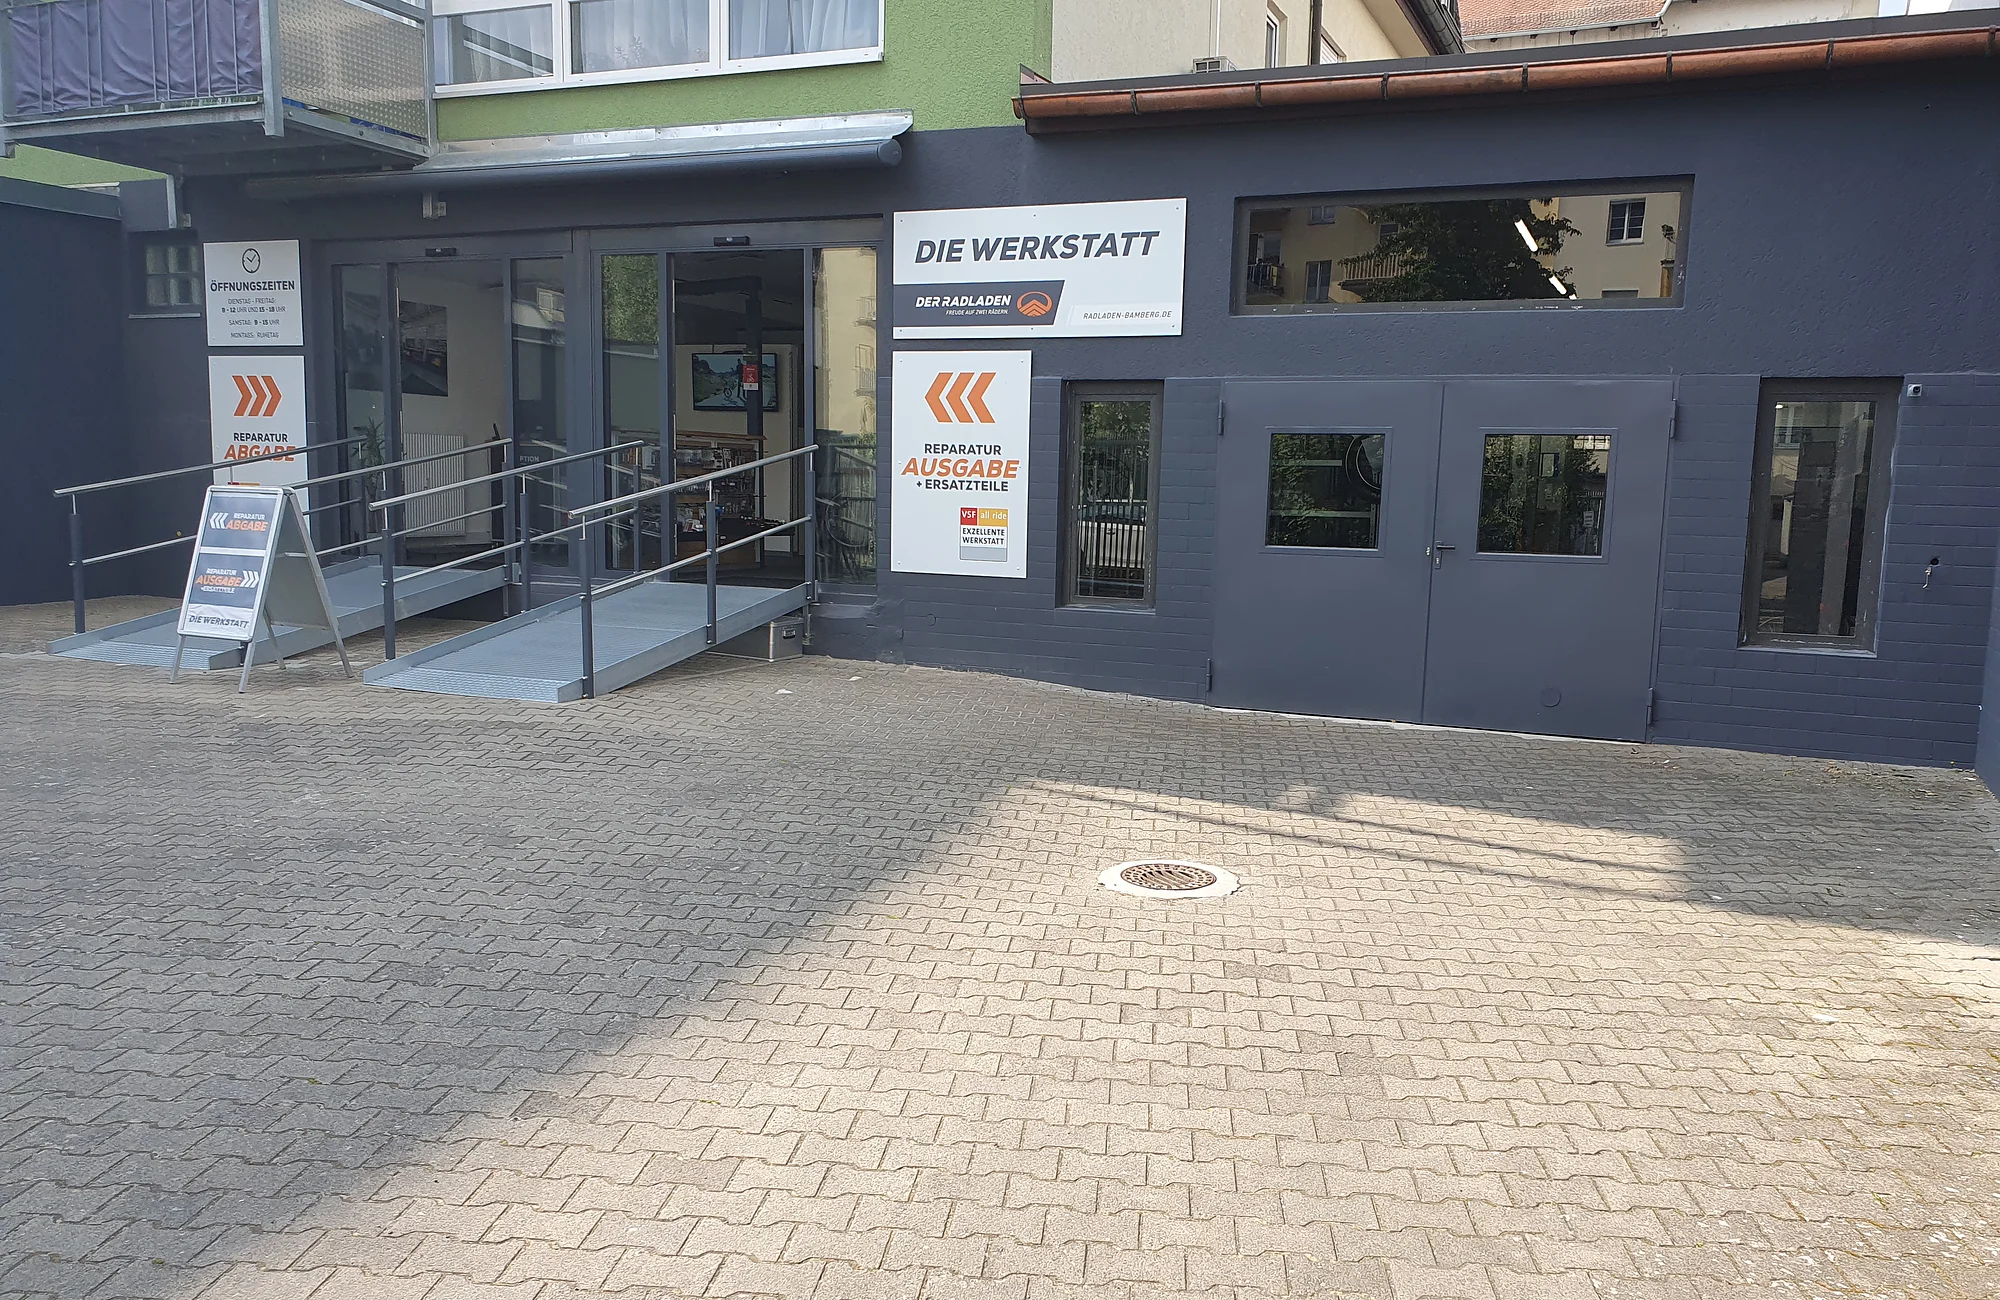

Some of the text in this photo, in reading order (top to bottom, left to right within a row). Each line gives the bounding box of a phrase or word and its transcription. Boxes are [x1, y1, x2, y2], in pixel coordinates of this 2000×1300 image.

[914, 230, 1161, 264] DIE WERKSTATT
[210, 279, 295, 292] ÖFFNUNGSZEITEN
[915, 294, 1012, 308] DER RADLADEN
[1082, 310, 1173, 320] RADLADEN-BAMBERG.DE
[233, 432, 288, 442] REPARATUR
[224, 444, 296, 462] ABGABE
[924, 443, 1002, 455] REPARATUR
[519, 455, 540, 463] PTION
[901, 457, 1020, 479] AUSGABE
[925, 479, 1009, 492] ERSATZTEILE
[233, 512, 265, 521] REPARATUR
[961, 510, 976, 519] VSF
[980, 511, 1007, 520] all ride
[225, 519, 269, 532] ABGABE
[962, 528, 1005, 536] EXZELLENTE
[962, 536, 1005, 545] WERKSTATT
[205, 567, 237, 576] REPARATUR
[195, 574, 243, 587] AUSGABE
[189, 615, 250, 629] DIE WERKSTATT
